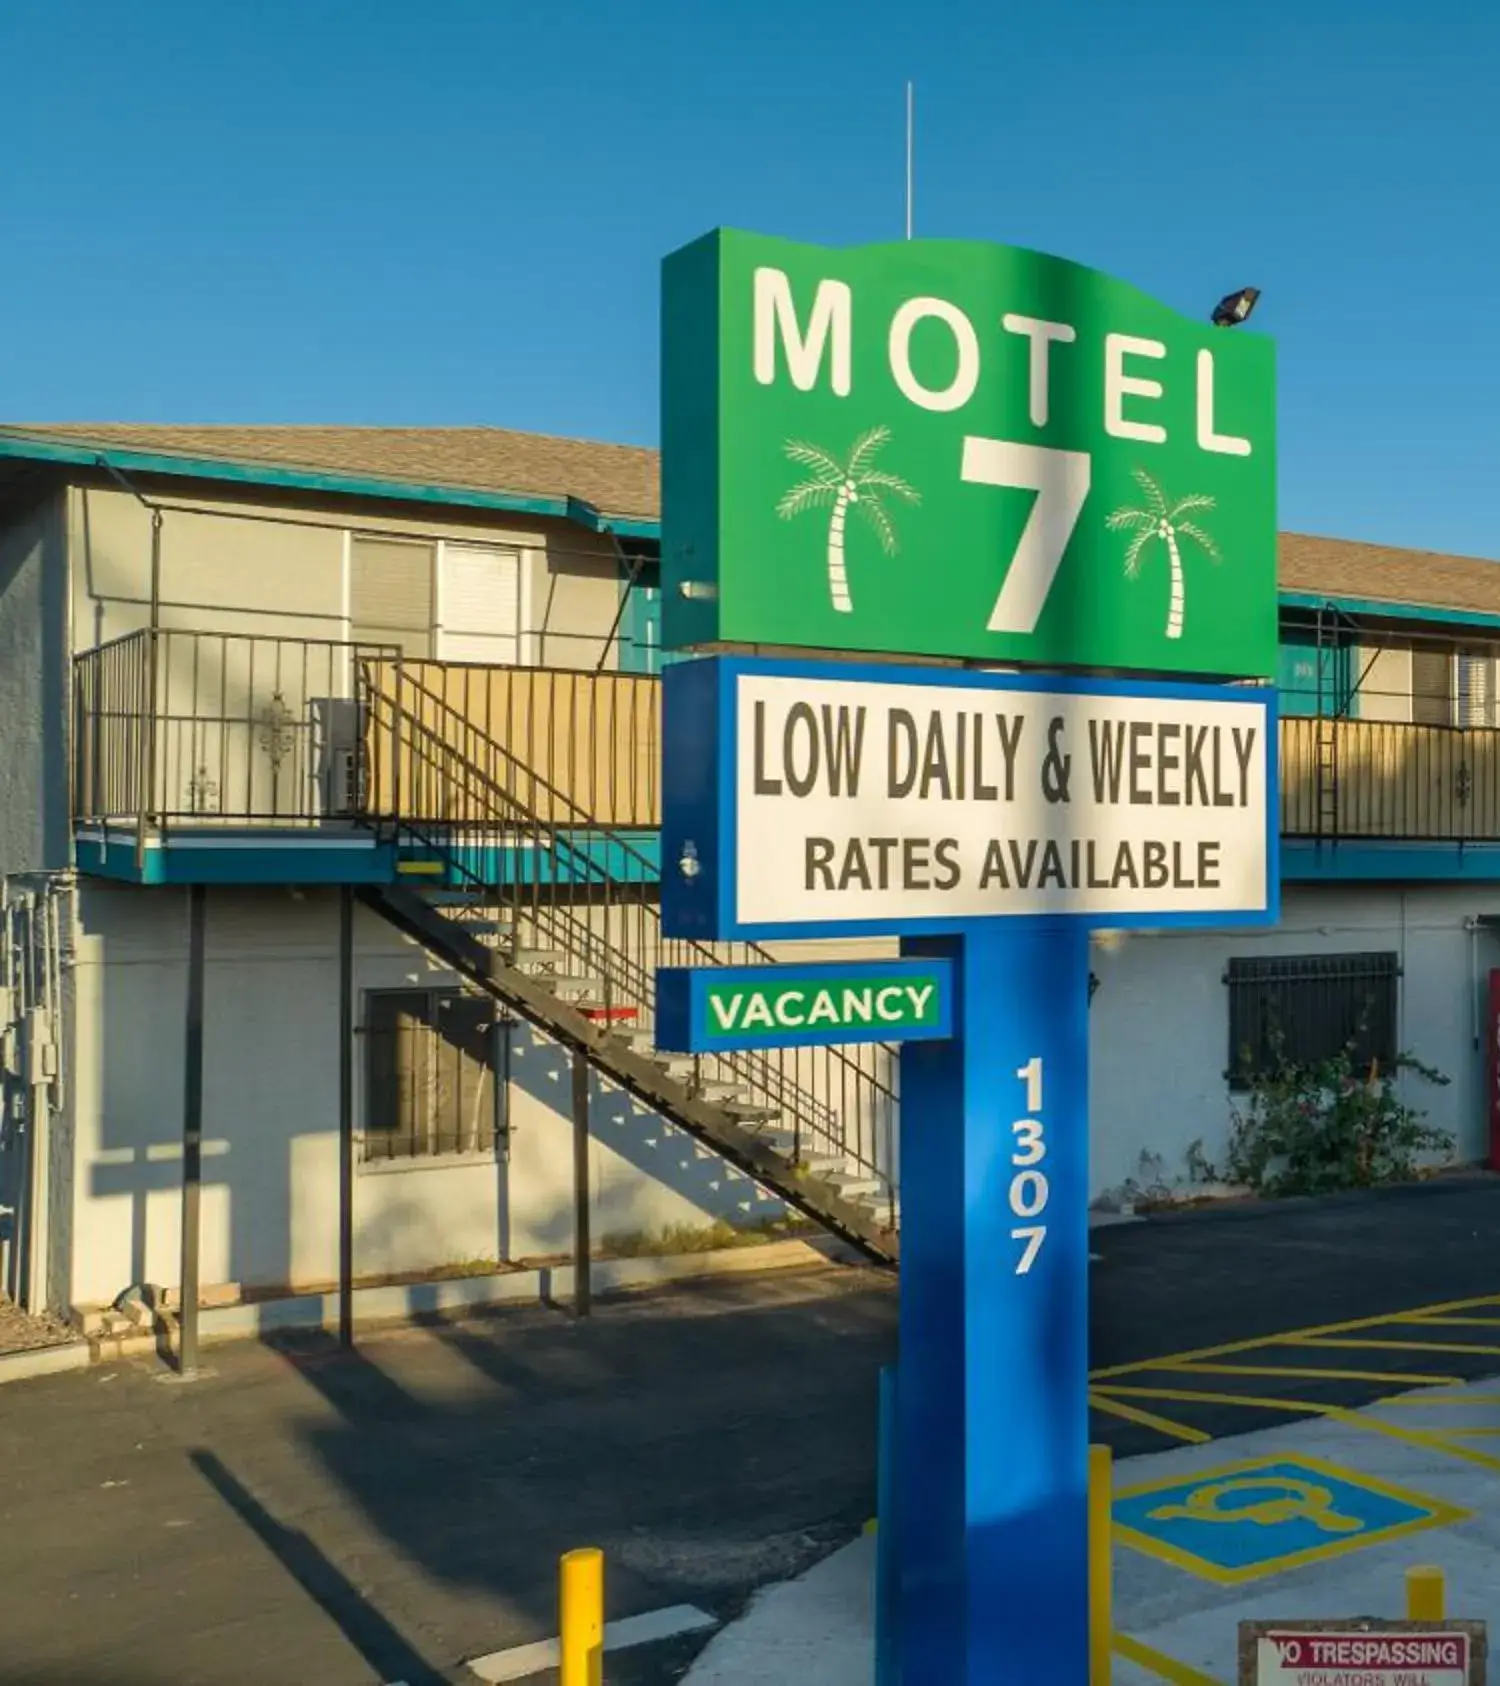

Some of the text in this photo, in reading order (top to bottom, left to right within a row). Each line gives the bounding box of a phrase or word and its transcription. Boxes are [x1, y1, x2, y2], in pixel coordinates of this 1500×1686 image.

[753, 266, 1252, 457] MOTEL
[959, 435, 1092, 634] 7
[753, 700, 1257, 808] LOW DAILY & WEEKLY
[803, 837, 1222, 892] RATES AVAILABLE
[709, 984, 935, 1031] VACANCY
[1008, 1057, 1050, 1276] 1307
[1310, 1641, 1458, 1665] TRESPASSING
